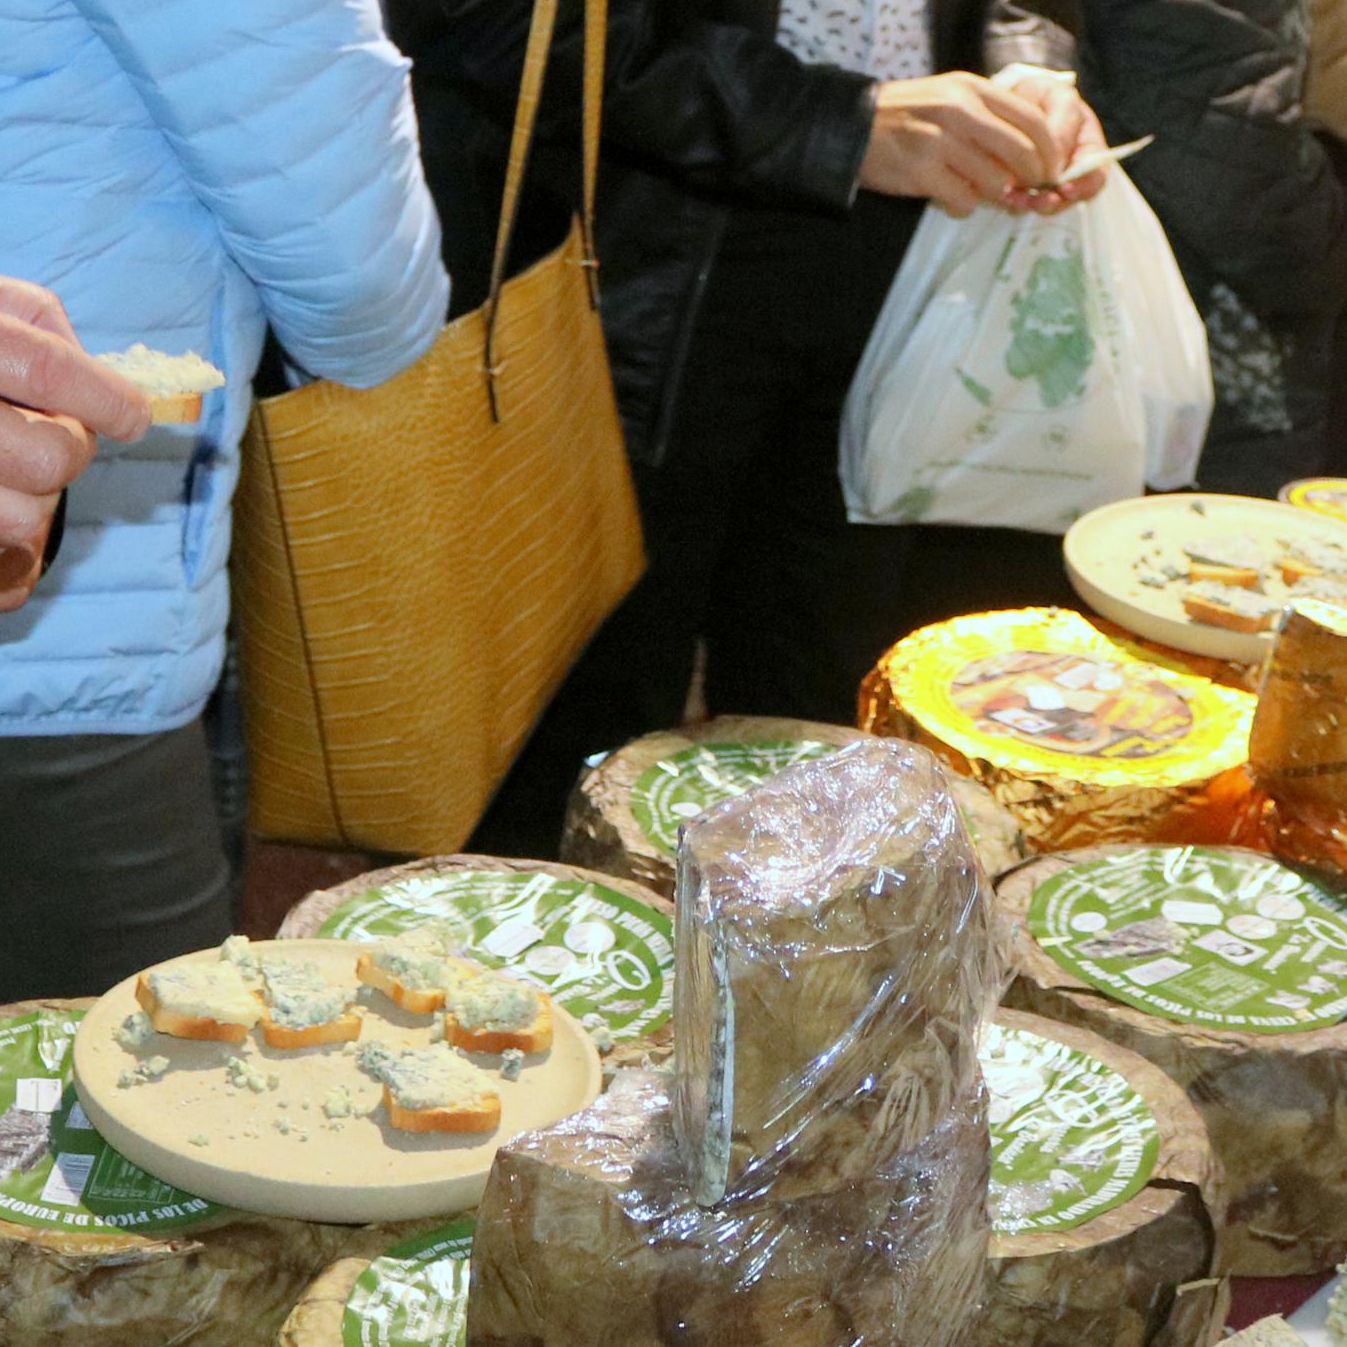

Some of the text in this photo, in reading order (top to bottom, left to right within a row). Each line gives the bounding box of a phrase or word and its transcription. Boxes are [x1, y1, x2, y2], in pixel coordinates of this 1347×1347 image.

[1144, 995, 1193, 1017] PICOS
[1196, 1010, 1223, 1023] LOS
[185, 1197, 209, 1214] DE
[1057, 1179, 1130, 1221] MADURADO
[63, 1212, 89, 1226] DE
[93, 1210, 151, 1227] PICOS
[152, 1203, 186, 1220] LOS
